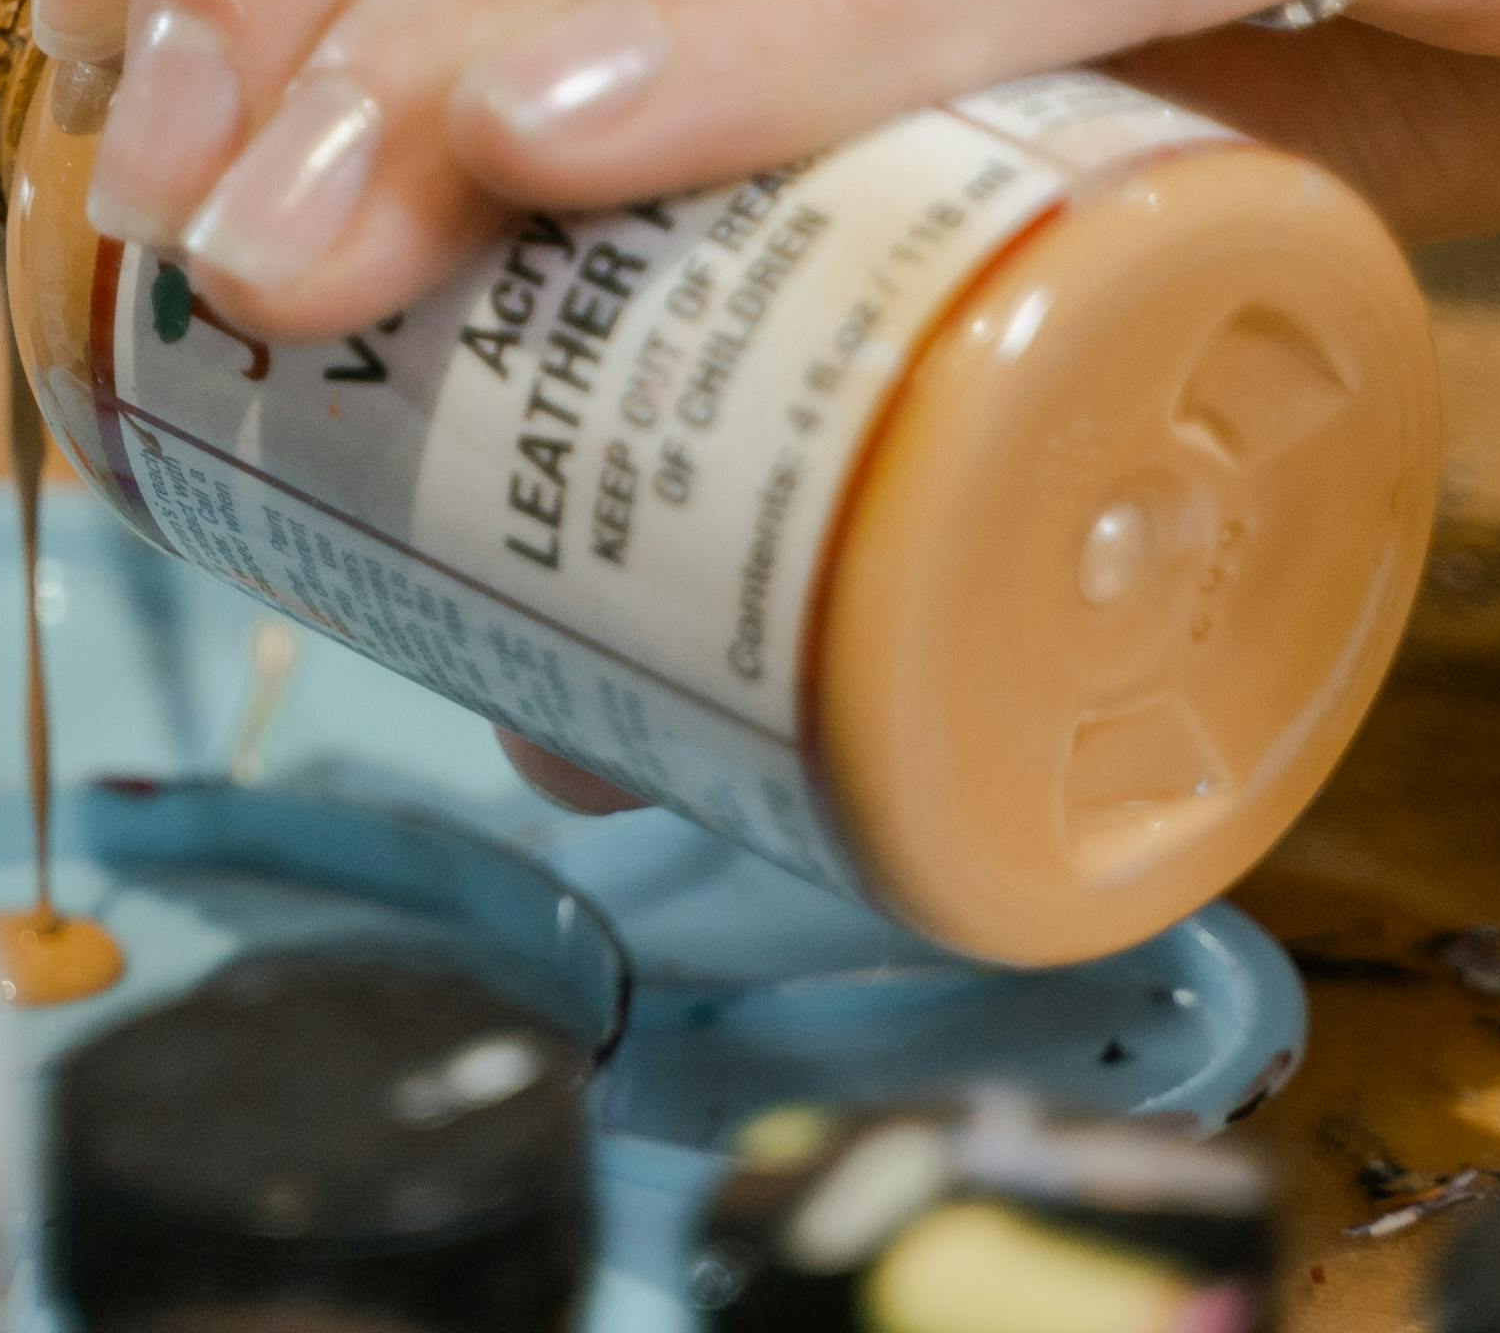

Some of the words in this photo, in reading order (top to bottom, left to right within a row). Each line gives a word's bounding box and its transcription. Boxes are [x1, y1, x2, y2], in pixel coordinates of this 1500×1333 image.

[459, 210, 577, 381] Acry
[504, 236, 649, 573] LEATHER
[676, 205, 831, 432] CHILDREN
[592, 439, 641, 570] KEEP
[620, 326, 682, 431] OUT
[666, 258, 720, 323] OF
[651, 440, 705, 507] OF
